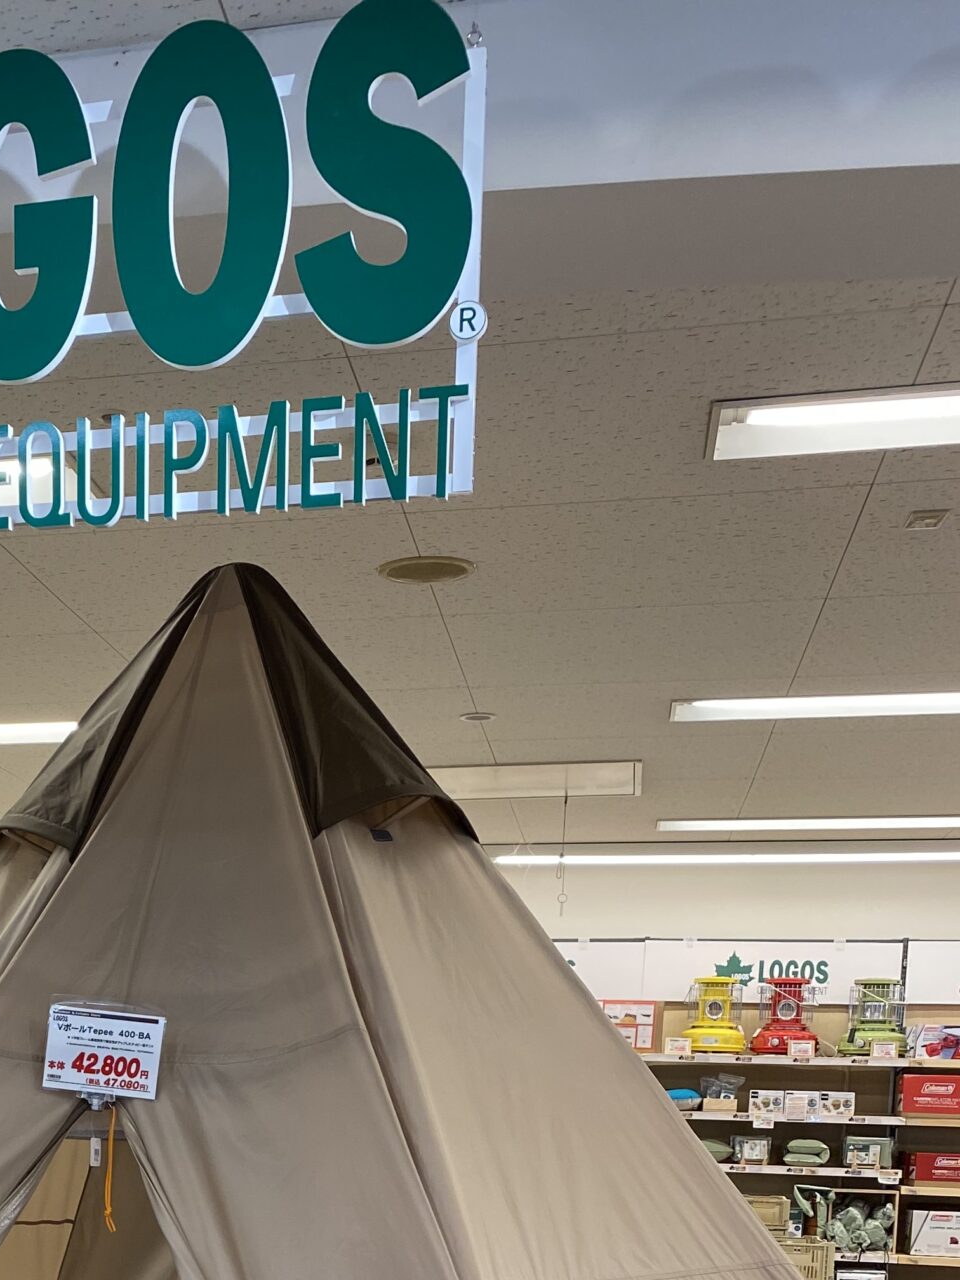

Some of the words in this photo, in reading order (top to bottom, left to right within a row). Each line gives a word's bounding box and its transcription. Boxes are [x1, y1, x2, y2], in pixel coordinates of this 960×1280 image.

[758, 960, 829, 985] LOGOS
[53, 1014, 68, 1023] LOGOS
[118, 1029, 151, 1041] 400-BA
[47, 1060, 66, 1071] 本体
